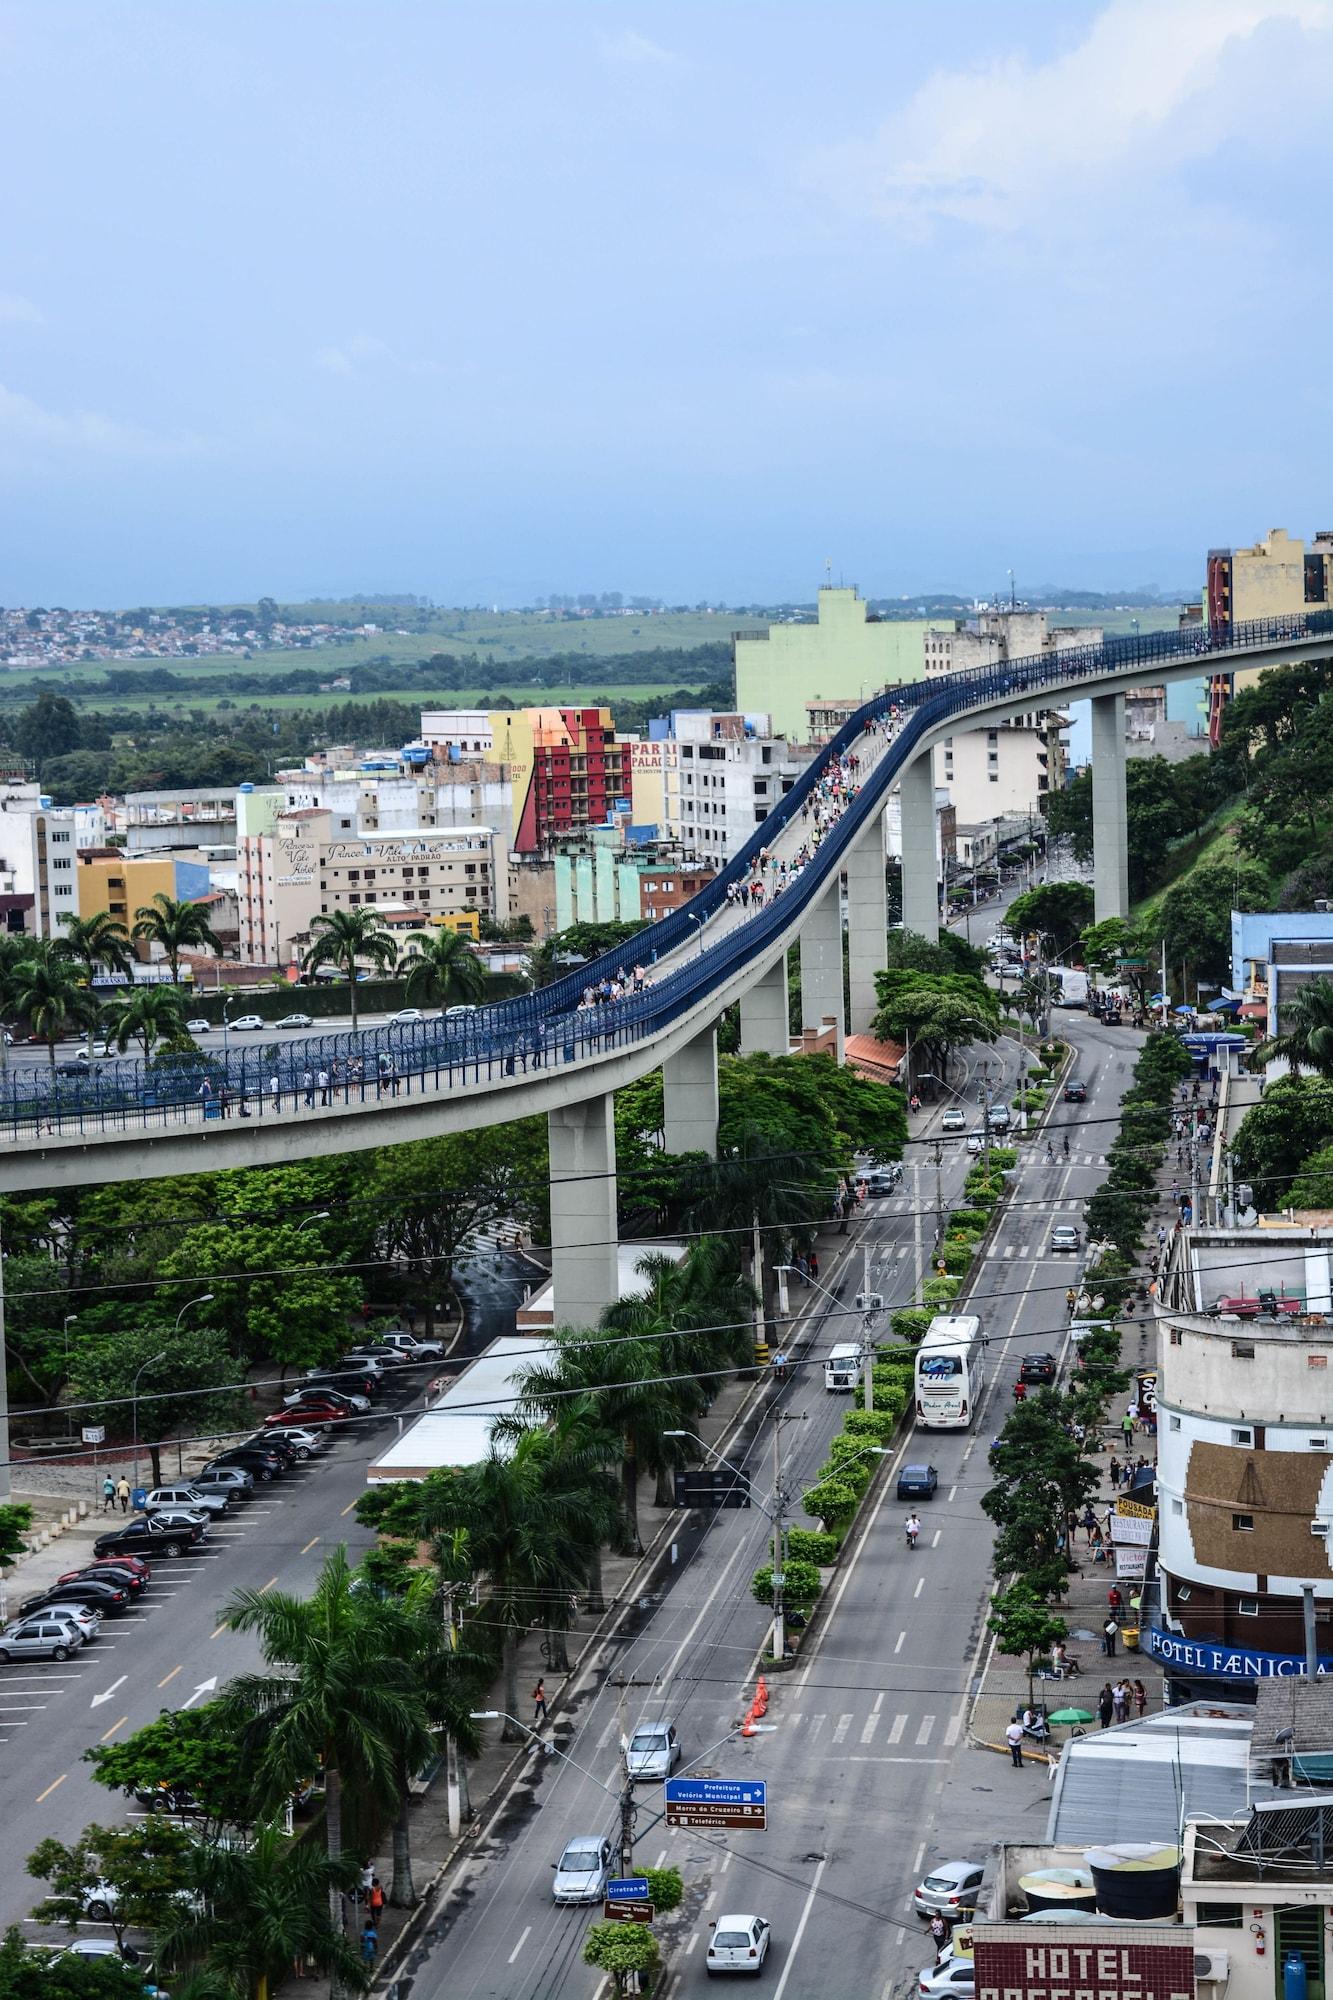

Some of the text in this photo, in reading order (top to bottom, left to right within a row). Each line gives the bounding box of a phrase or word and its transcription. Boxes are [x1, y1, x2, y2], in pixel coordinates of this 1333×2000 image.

[291, 862, 317, 876] Hotel
[1119, 1499, 1152, 1516] POUSADA
[1112, 1518, 1151, 1531] RESTAURANTE
[1152, 1632, 1206, 1669] HOTEL
[678, 1791, 702, 1799] Velório
[690, 1817, 726, 1825] Teleférico
[1026, 1948, 1141, 1981] HOTEL
